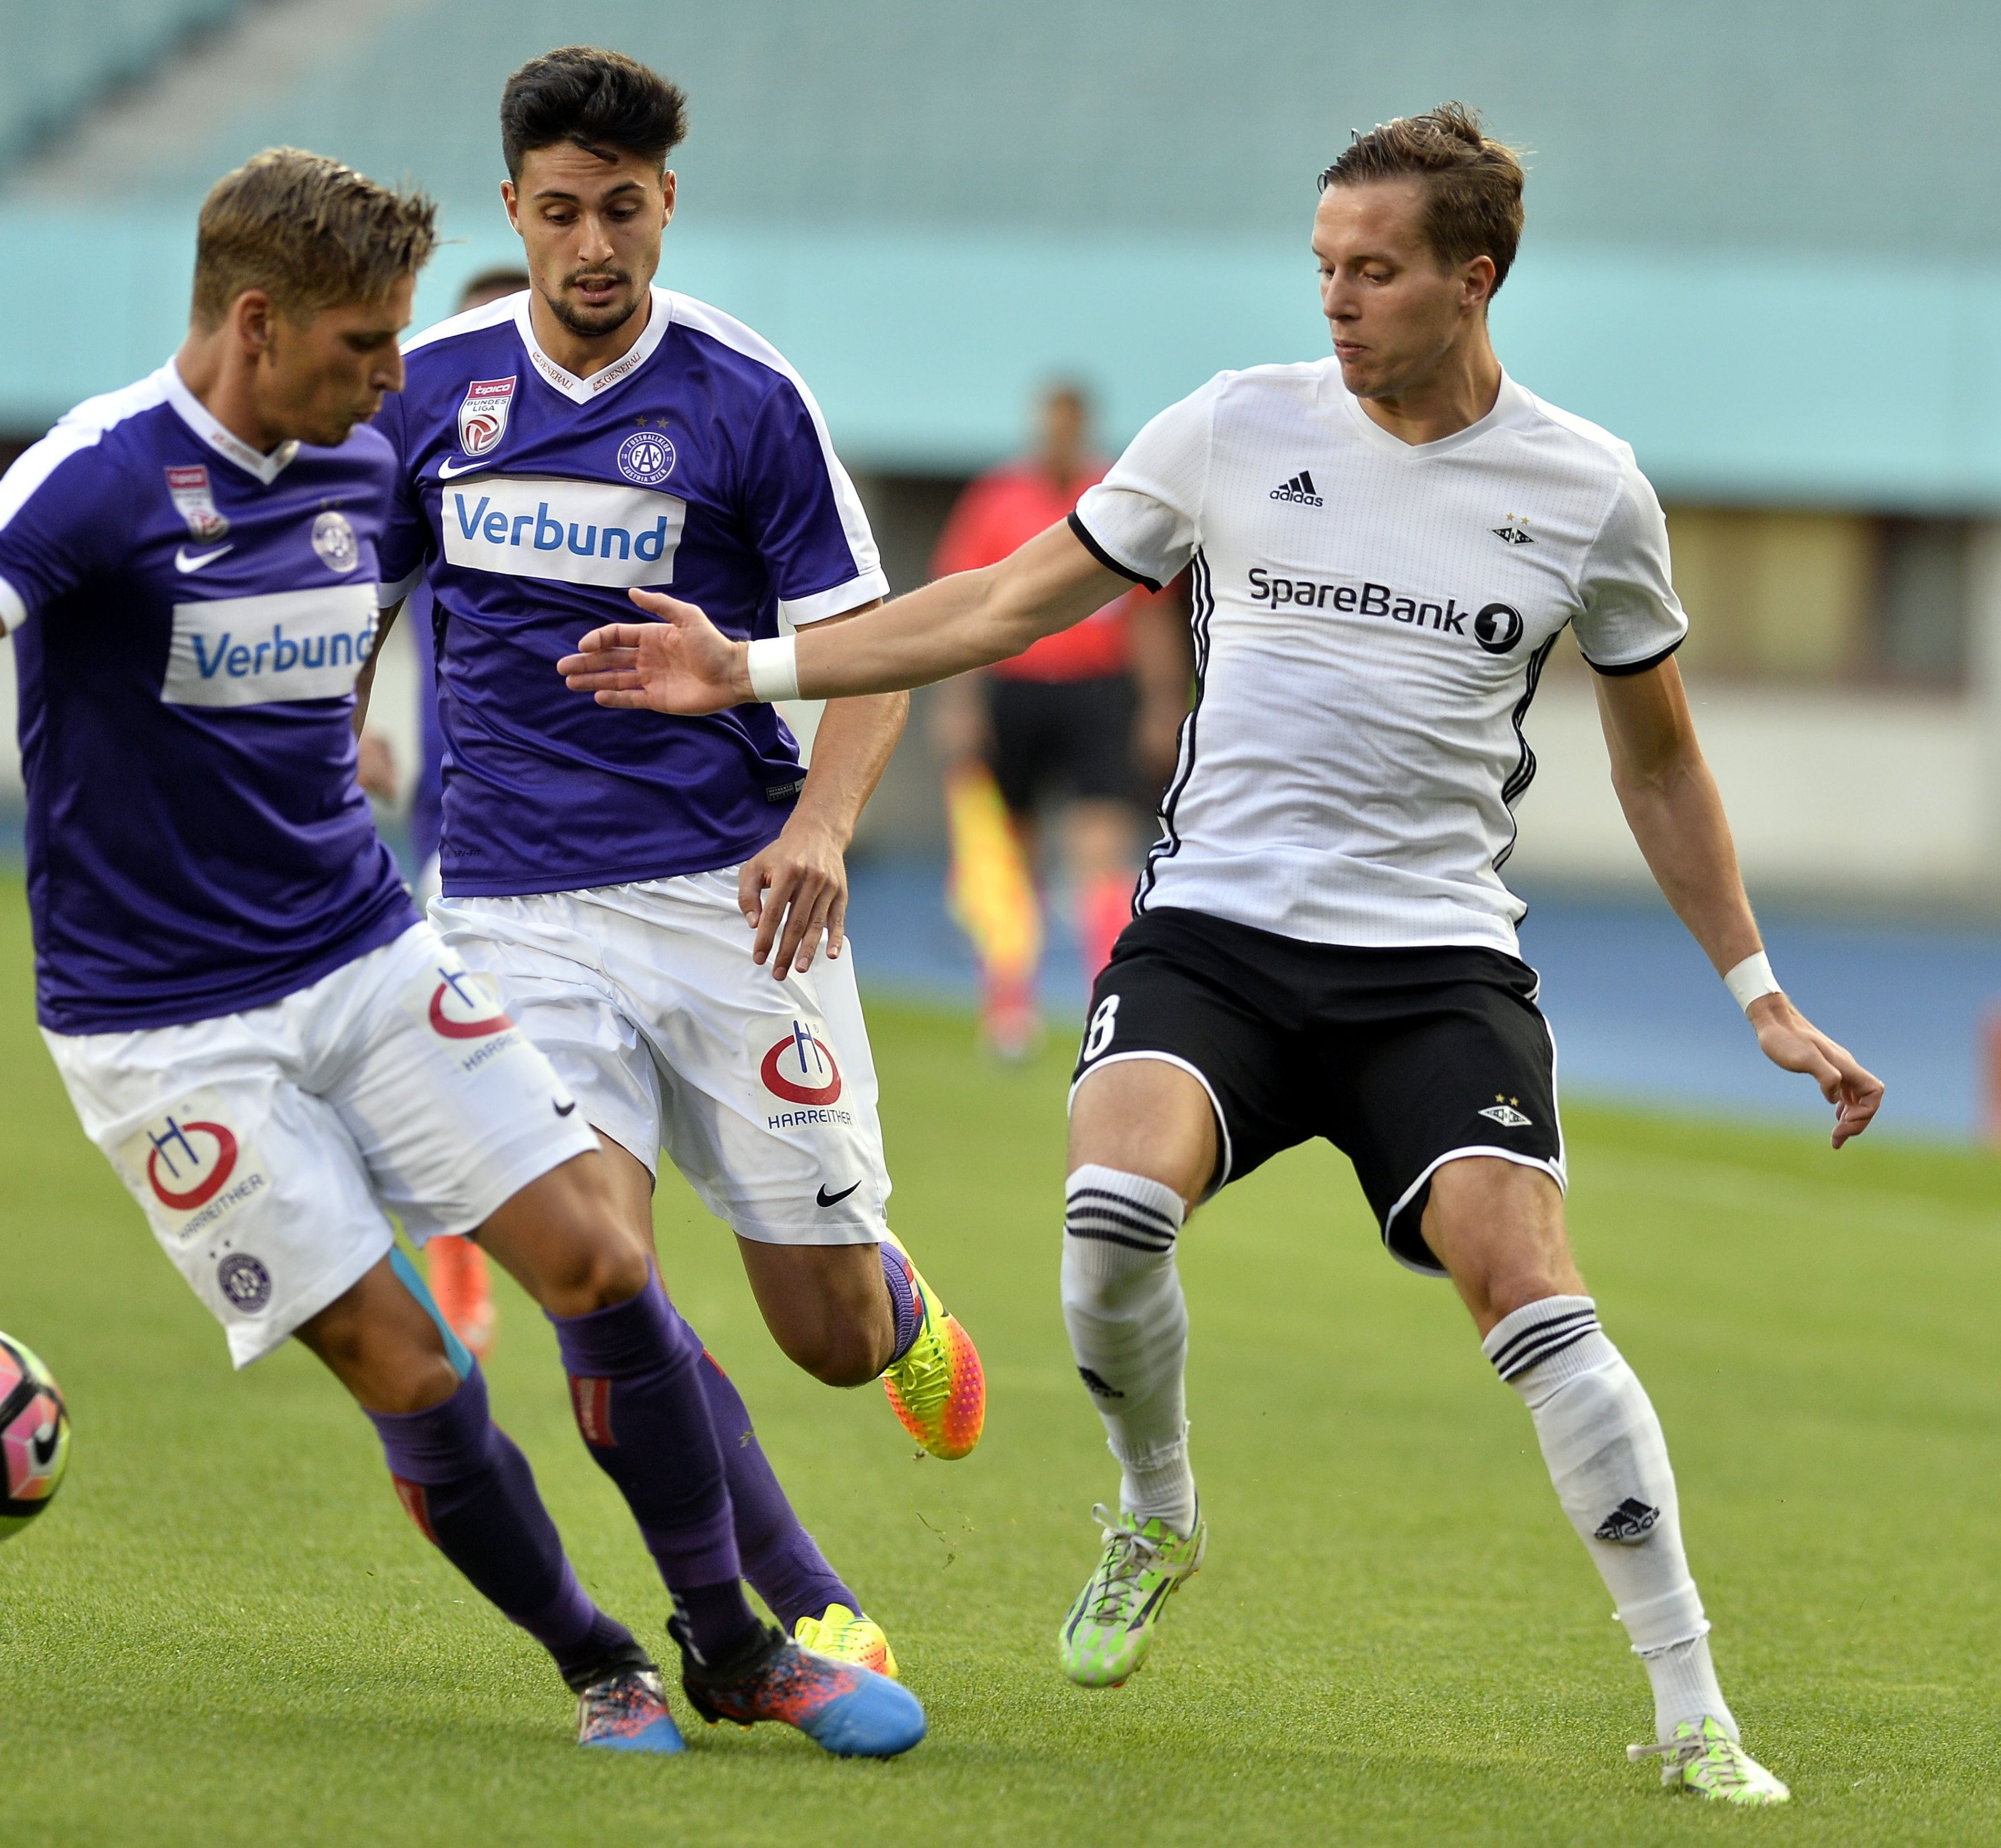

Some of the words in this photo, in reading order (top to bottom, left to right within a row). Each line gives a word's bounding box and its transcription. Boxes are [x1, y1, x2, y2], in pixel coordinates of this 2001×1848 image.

[539, 358, 574, 390] GENERALI
[603, 351, 642, 383] GENERALI
[475, 383, 511, 395] tipico
[466, 398, 508, 406] BUNDES
[626, 435, 672, 452] FUSSBALLKLUB
[623, 465, 648, 482] AUSTRIA
[649, 468, 667, 482] WIEN
[1269, 488, 1323, 507] adidas
[454, 493, 668, 562] Verbund
[1248, 568, 1469, 636] SpareBank
[1083, 994, 1120, 1063] 8
[767, 1109, 853, 1130] HARREITHER
